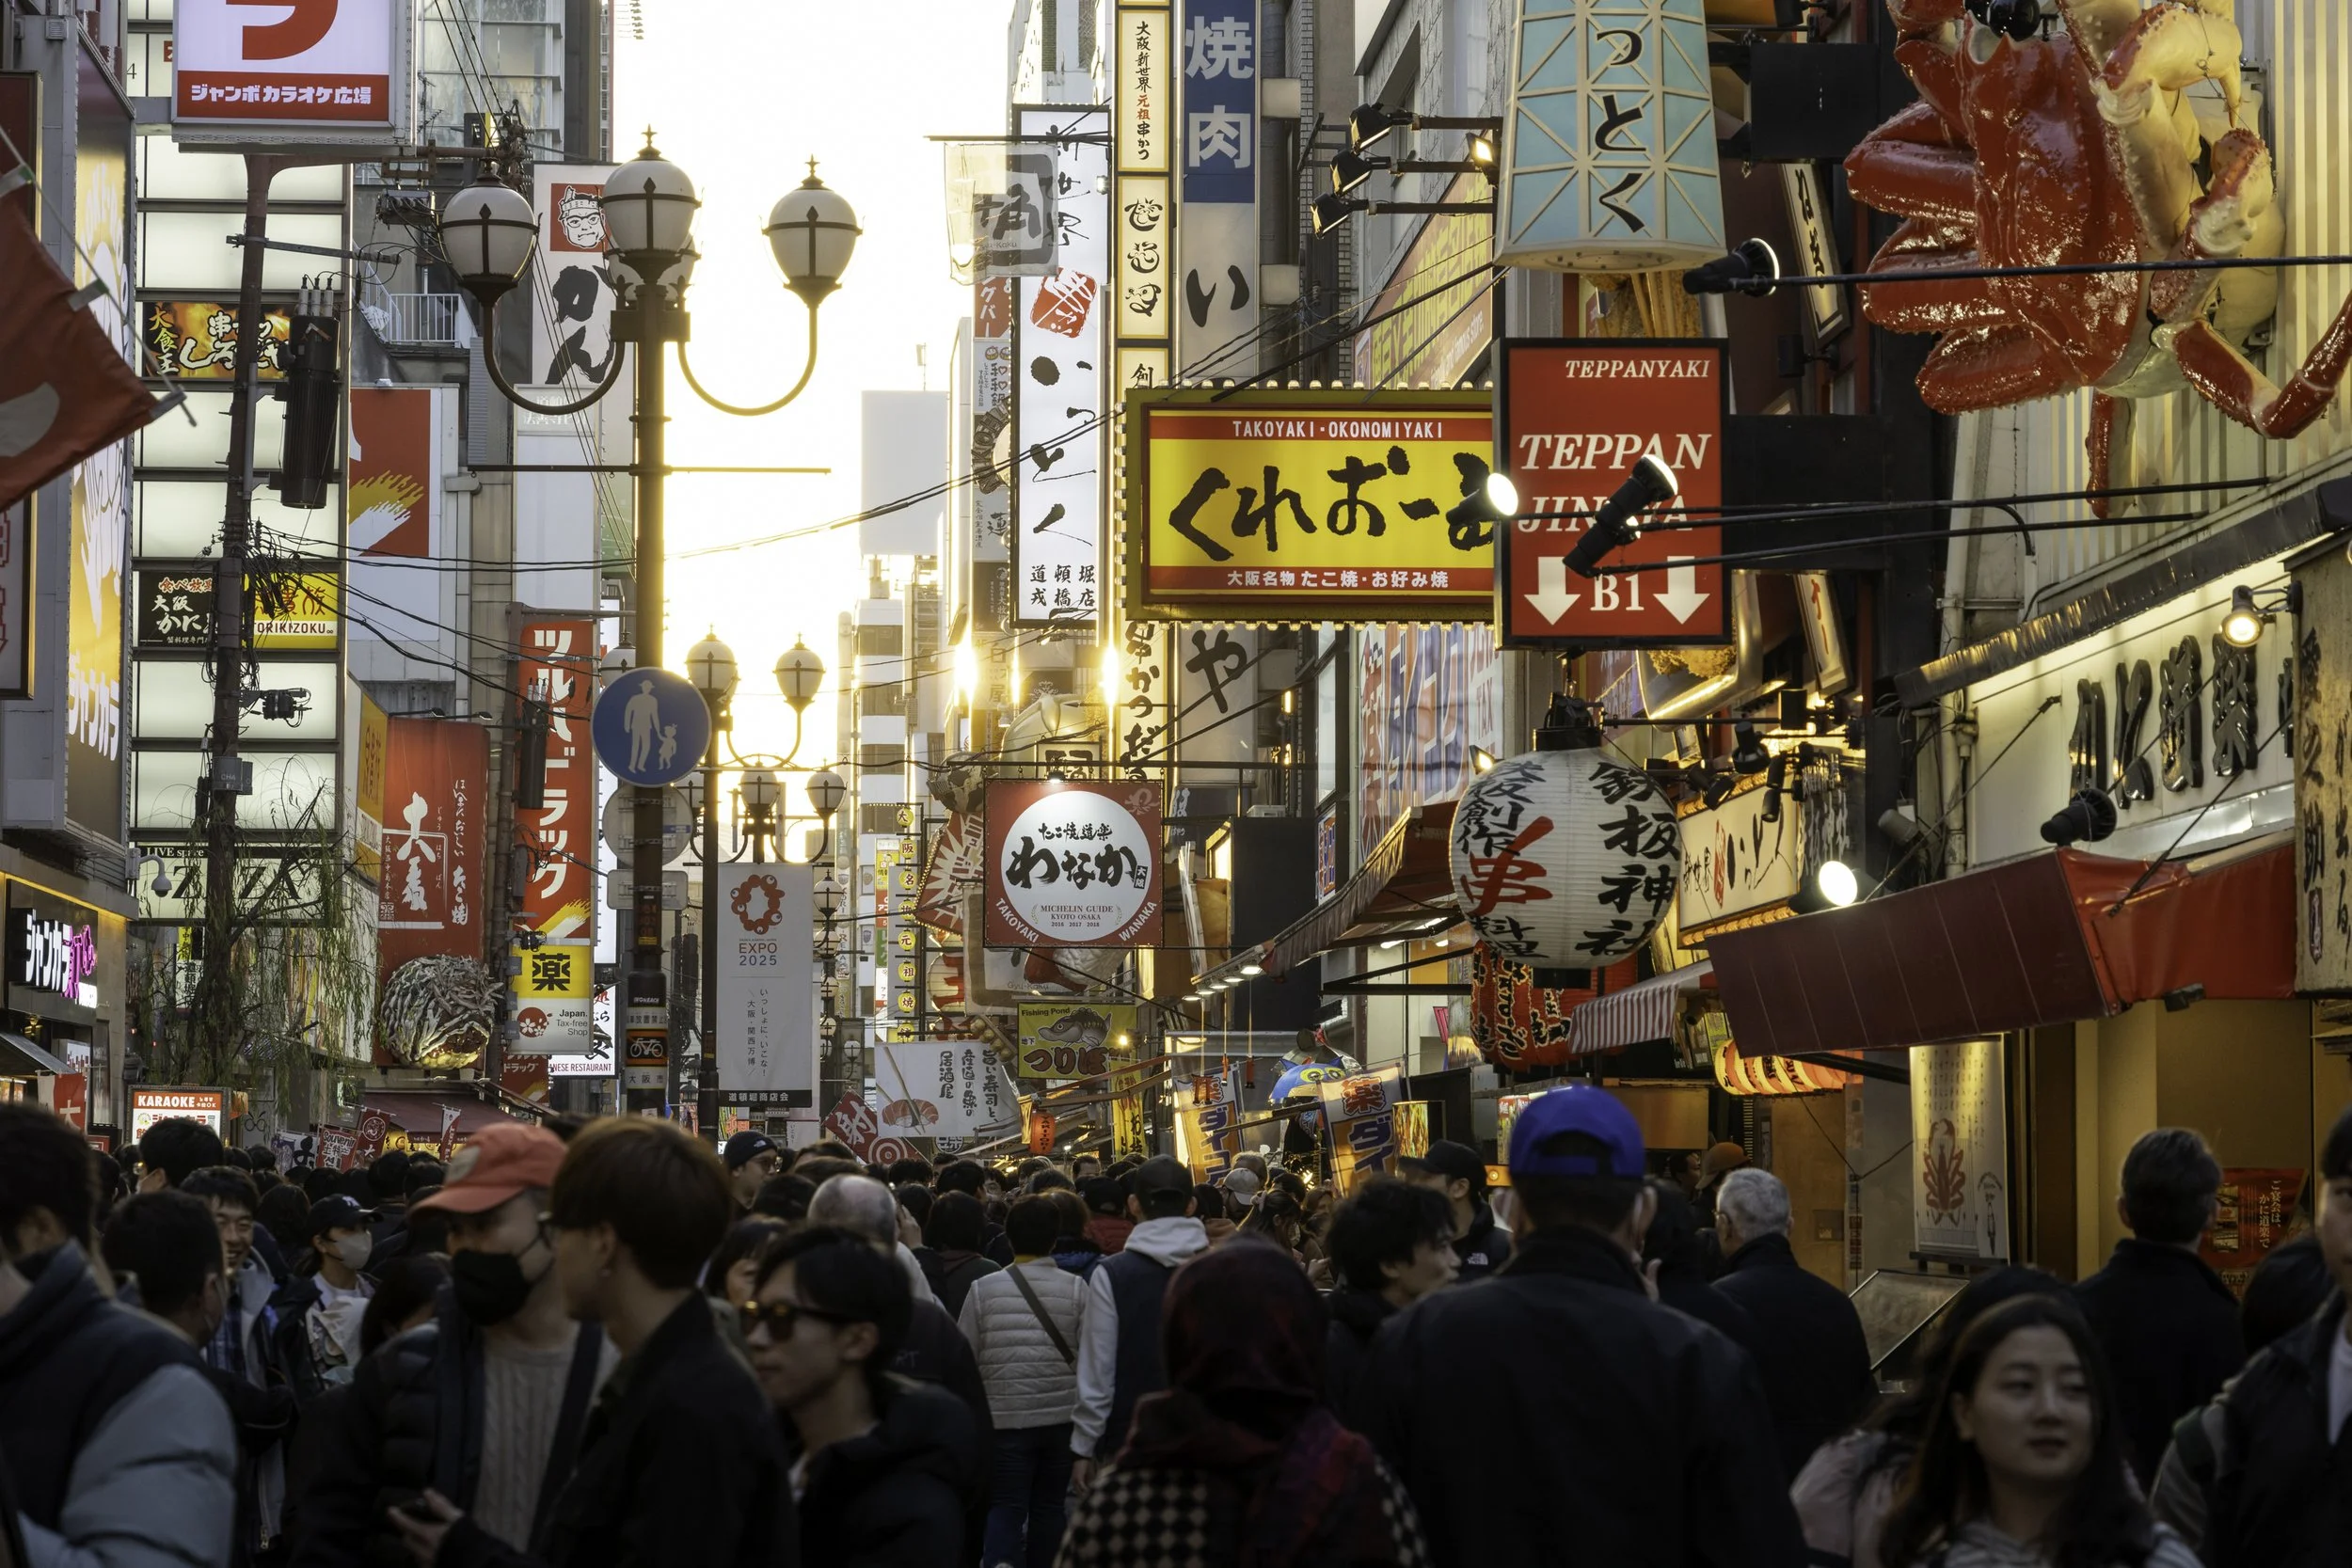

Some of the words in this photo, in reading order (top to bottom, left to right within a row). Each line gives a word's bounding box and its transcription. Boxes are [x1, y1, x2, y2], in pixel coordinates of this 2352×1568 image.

[191, 83, 372, 105] ジャンボカラオケ広場
[1134, 20, 1152, 161] 大阪新世界元祖串かつ
[1184, 15, 1255, 169] 焼肉
[208, 311, 275, 339] 串つ
[149, 307, 180, 374] 大食王
[1565, 358, 1711, 379] TEPPANYAKI
[1519, 433, 1712, 470] TEPPAN
[1030, 563, 1095, 584] 道頓堀
[1227, 570, 1295, 589] 大阪名物
[1030, 587, 1095, 609] 戎橋店
[1589, 572, 1645, 612] B1
[151, 594, 194, 612] 大阪
[166, 636, 211, 644] 蟹料理専門
[1038, 821, 1113, 842] たこ焼道楽
[146, 847, 176, 857] LIVE
[1005, 835, 1138, 891] わなか
[1041, 905, 1083, 913] MICHELIN
[1086, 905, 1114, 913] GUIDE
[995, 897, 1040, 943] TAKOYAKI
[1118, 900, 1158, 942] WANAKA
[739, 942, 778, 954] EXPO
[739, 955, 777, 966] 2025
[532, 953, 571, 991] 薬
[559, 1009, 588, 1019] Japan.
[1021, 1007, 1050, 1016] Fishing
[1050, 1006, 1071, 1015] Pond
[556, 1019, 588, 1028] Tax-free
[566, 1028, 589, 1037] Shop
[503, 1063, 539, 1074] ドラッグ
[570, 1063, 612, 1072] RESTAURANT
[939, 1050, 955, 1100] 居酒屋
[137, 1095, 196, 1108] KARAOKE
[728, 1092, 789, 1102] 道頓堀商店会
[323, 1129, 357, 1148] Souvenir
